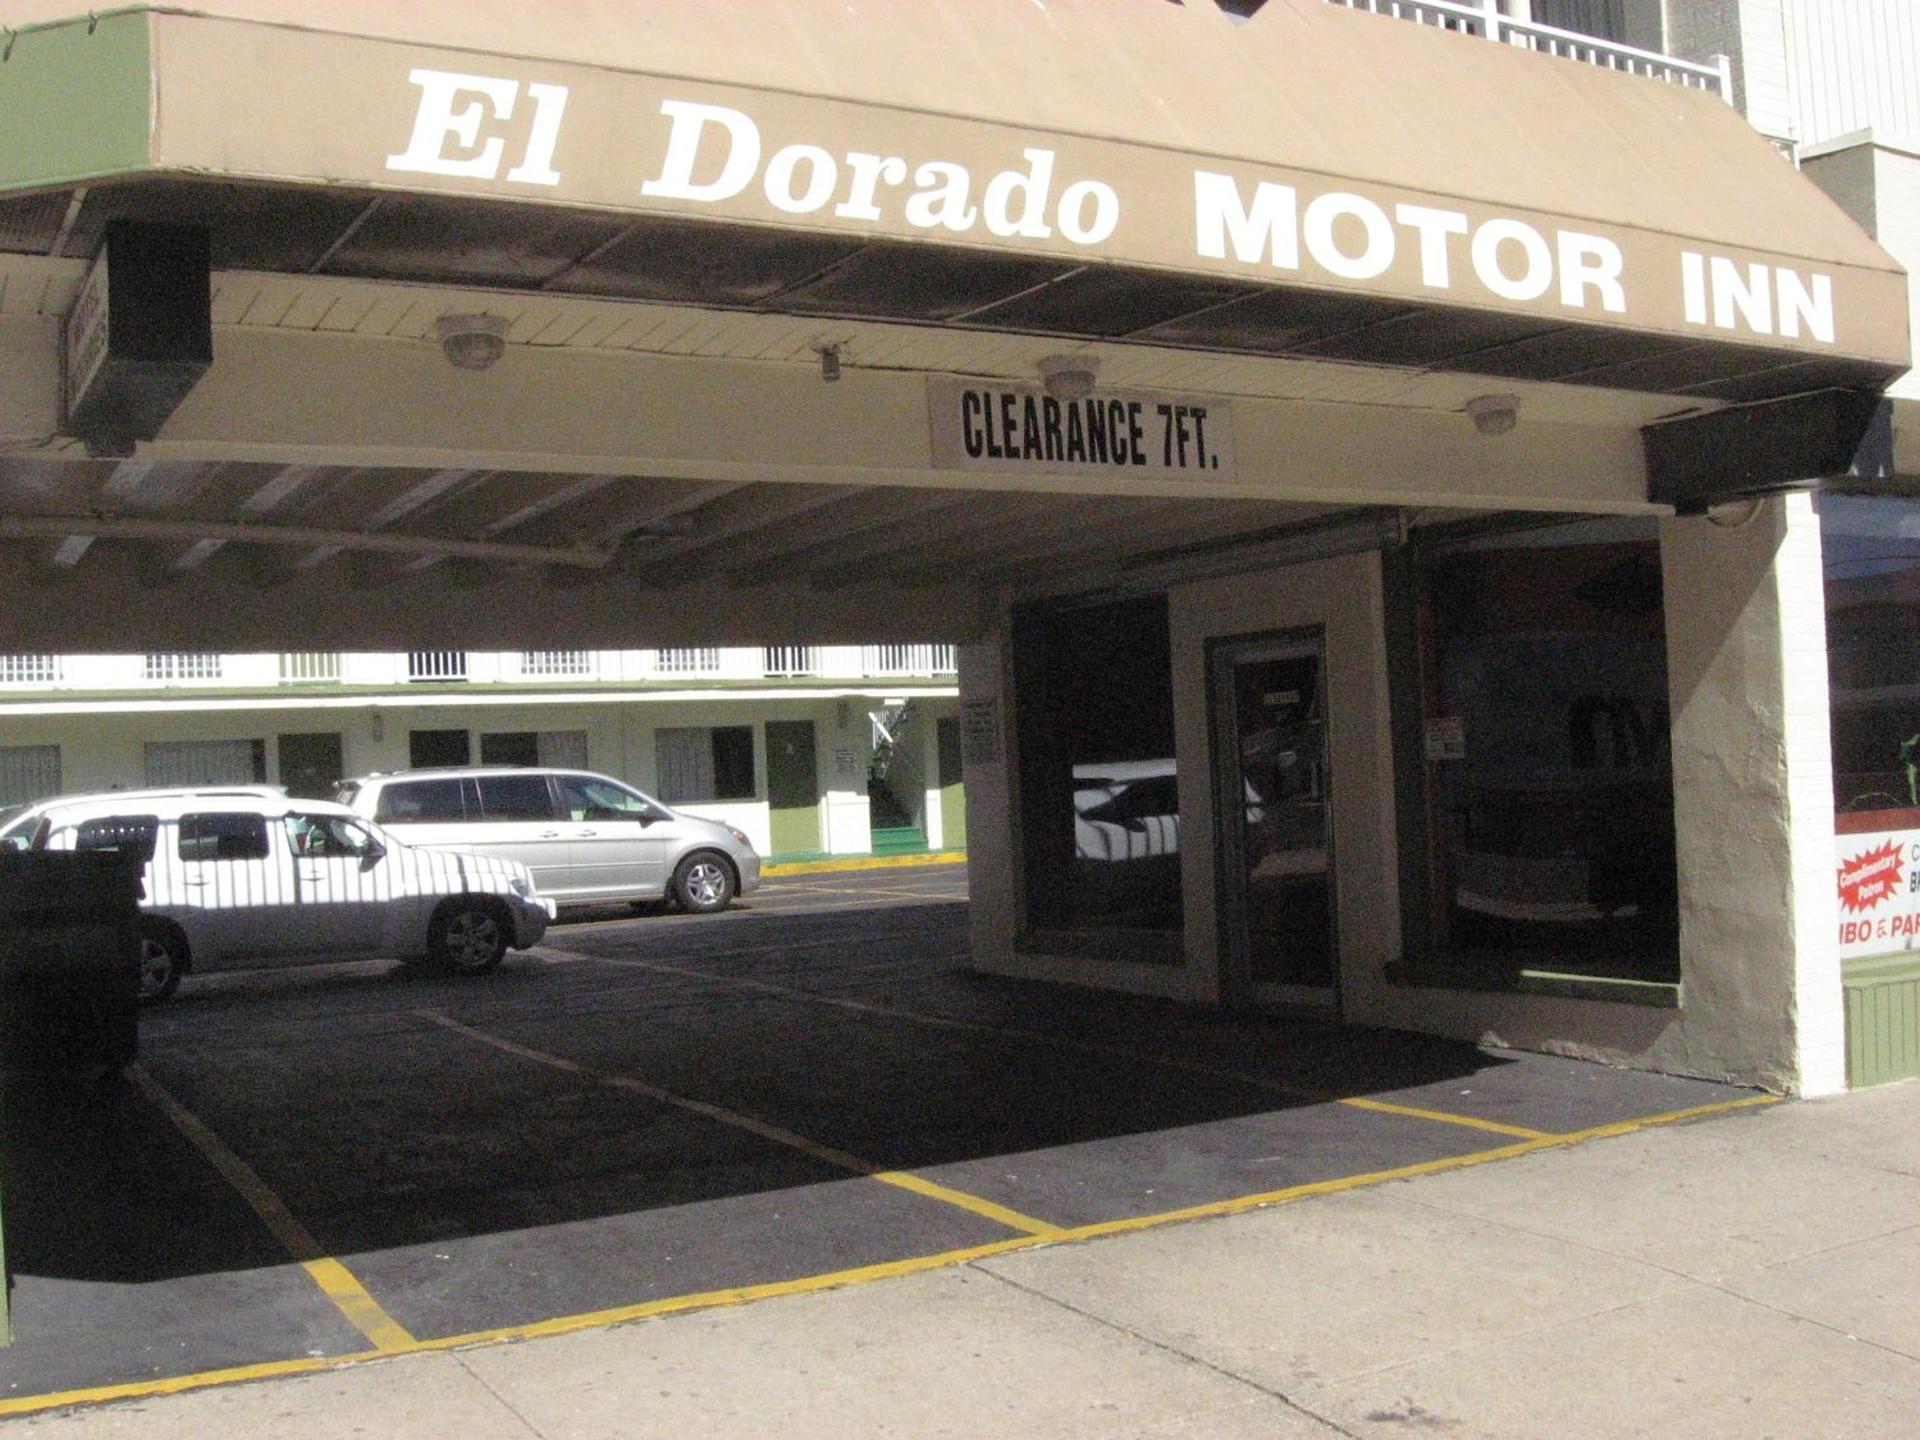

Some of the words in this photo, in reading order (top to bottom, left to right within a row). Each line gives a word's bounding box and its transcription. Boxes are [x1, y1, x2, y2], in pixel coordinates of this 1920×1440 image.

[385, 68, 569, 186] El
[641, 99, 1120, 250] Dorado
[1194, 170, 1626, 314] MOTOR
[1681, 251, 1836, 344] INN
[961, 389, 1147, 466] CLEARANCE
[1156, 403, 1219, 470] 7FT.
